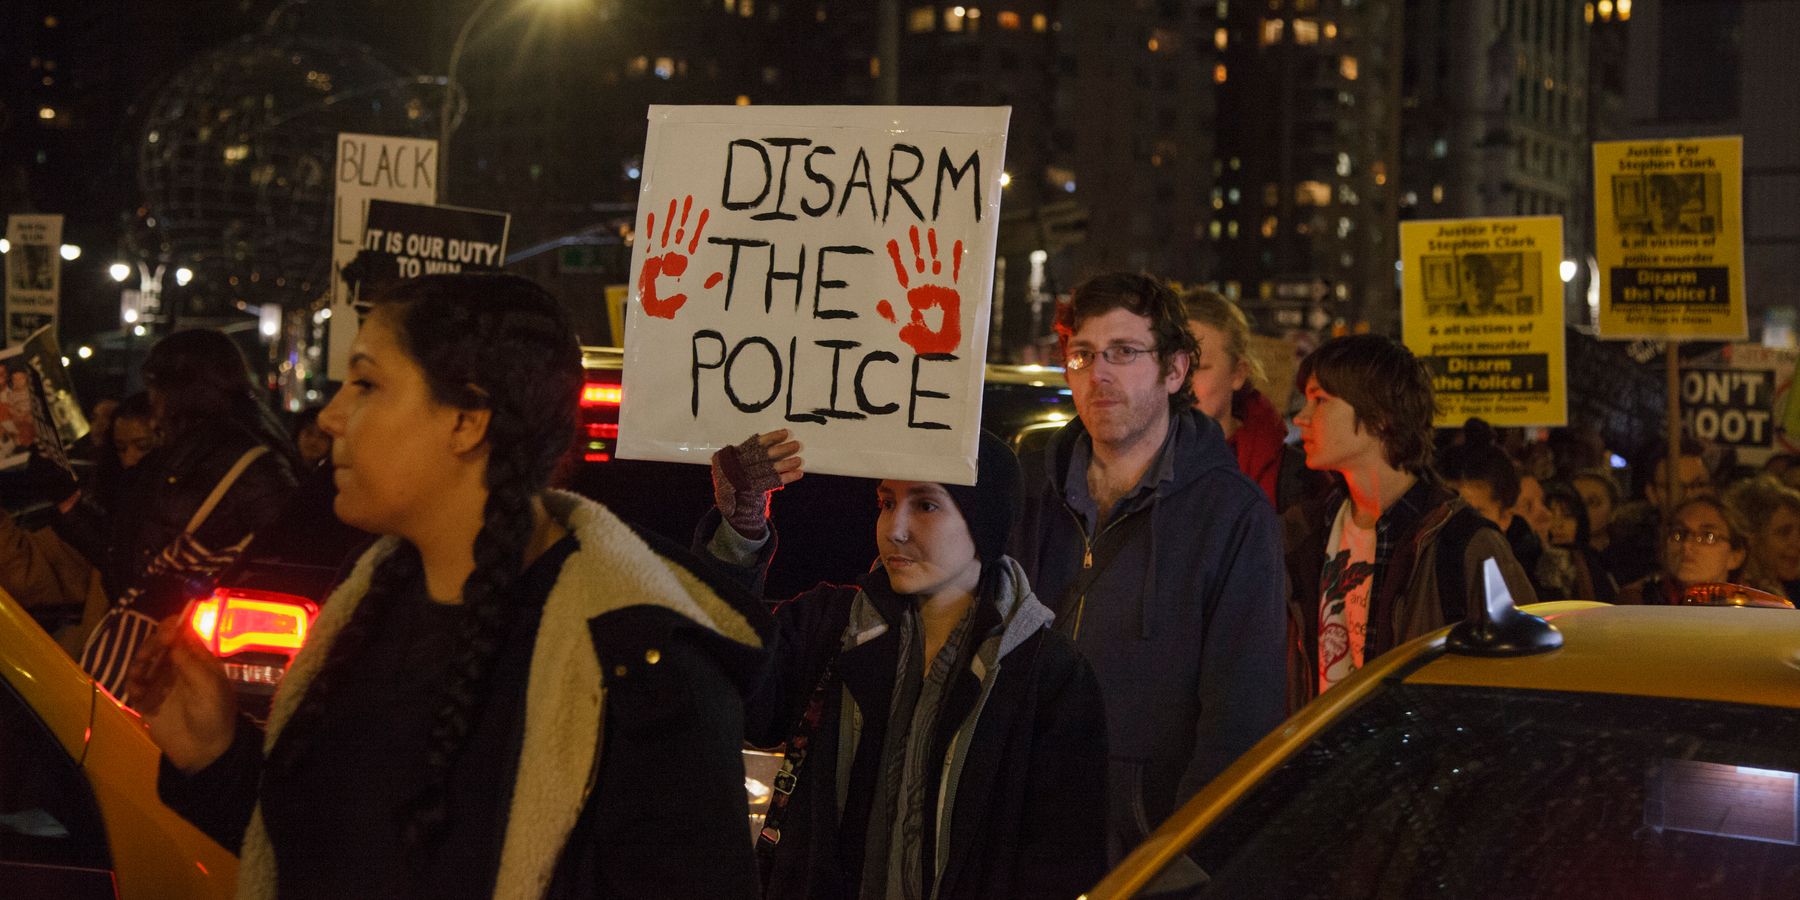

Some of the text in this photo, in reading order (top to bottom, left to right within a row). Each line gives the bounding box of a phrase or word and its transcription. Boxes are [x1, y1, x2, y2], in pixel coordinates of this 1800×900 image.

[1627, 144, 1700, 157] Justice For
[341, 140, 433, 189] BLACK
[1618, 158, 1716, 174] Stephen Clark
[721, 137, 983, 225] DISARM
[1437, 224, 1518, 238] Justice For
[366, 229, 499, 267] IT IS OUR DUTY
[1428, 236, 1535, 251] Stephen Clark
[396, 256, 421, 279] TO
[707, 237, 875, 319] THE
[1636, 270, 1698, 285] Disarm
[1624, 287, 1651, 302] the
[1429, 322, 1534, 336] & all victims of
[1431, 340, 1530, 356] police murder
[1447, 357, 1512, 373] Disarm
[691, 329, 960, 430] POLICE
[1432, 375, 1463, 391] the
[1682, 370, 1764, 406] ON'T
[1686, 407, 1770, 443] OOT
